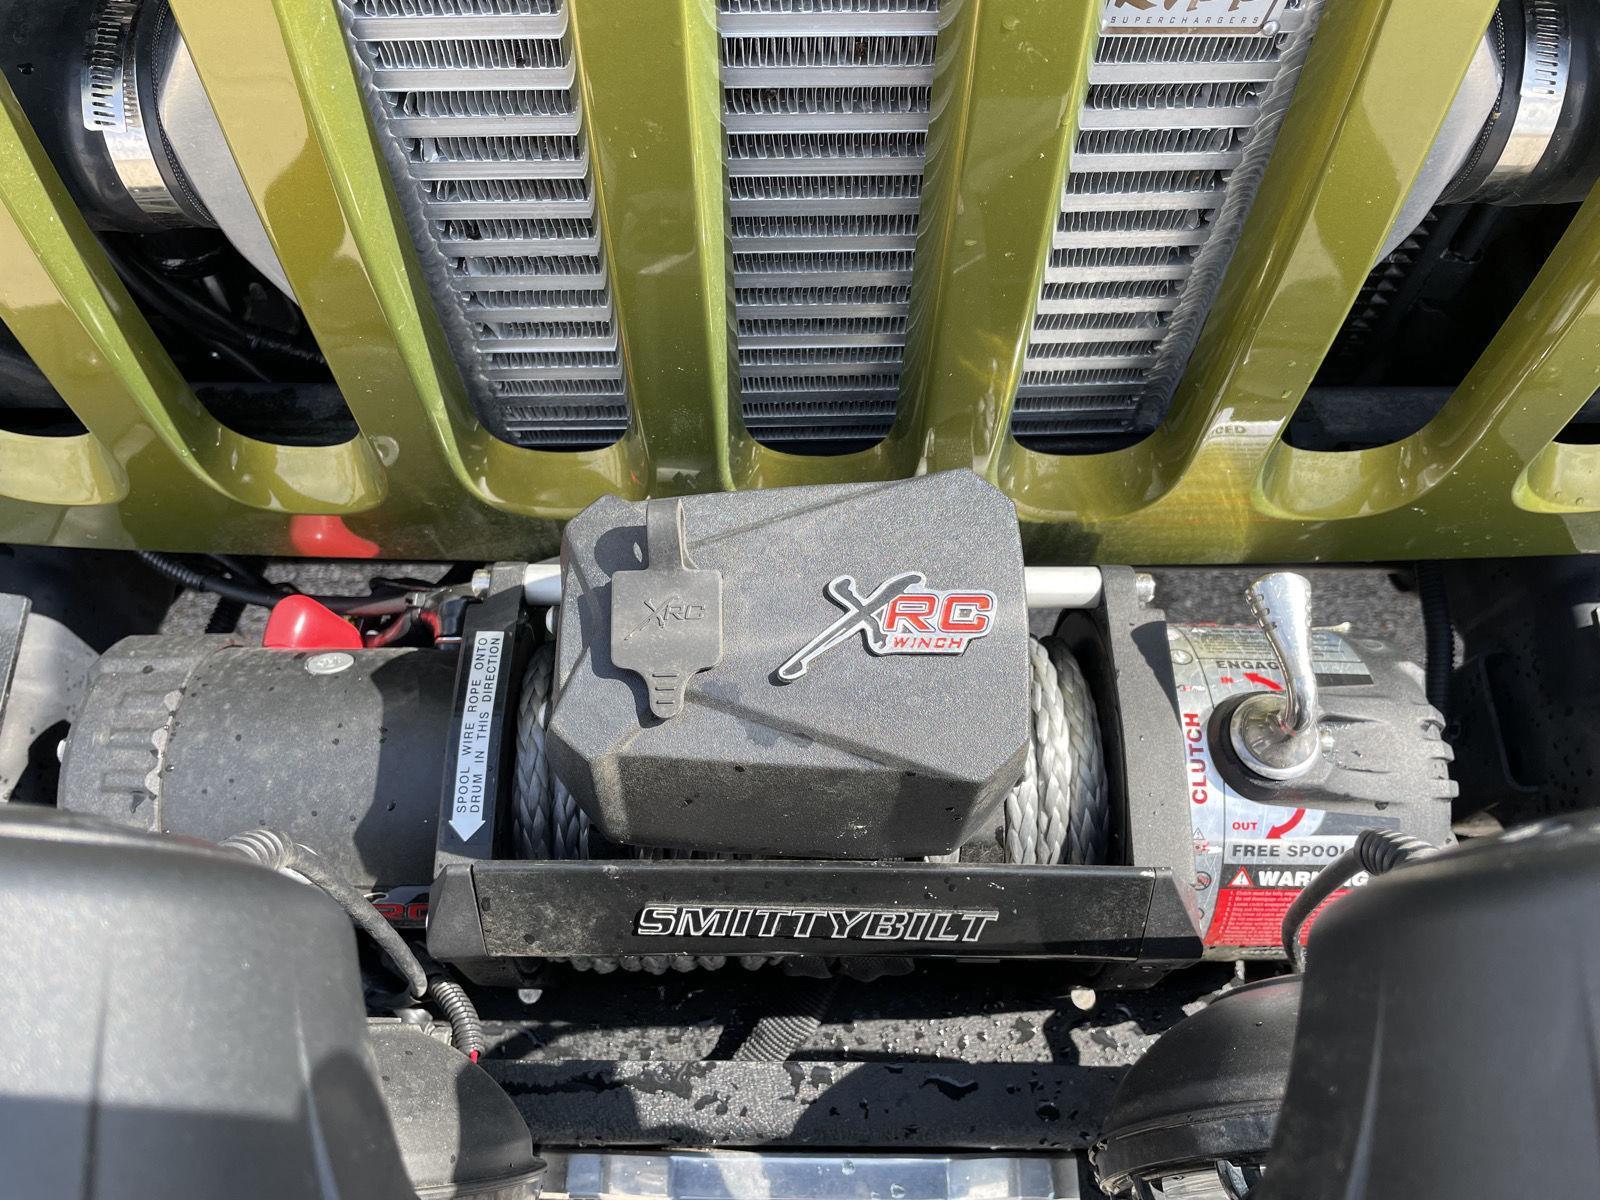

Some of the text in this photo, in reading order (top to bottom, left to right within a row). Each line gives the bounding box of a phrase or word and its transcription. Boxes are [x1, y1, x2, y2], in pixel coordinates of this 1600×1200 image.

[1110, 16, 1259, 25] SUPERCHARGERS
[777, 571, 997, 683] XRC
[893, 636, 963, 650] WINCH
[1216, 660, 1280, 670] ENGAG
[457, 637, 487, 813] SPOOL WIRE ROPE ONTO
[470, 637, 501, 813] DRUM IN THIS DIRECTION
[1183, 713, 1208, 805] CLUTCH
[1232, 821, 1258, 831] OUT
[1232, 844, 1280, 858] FREE
[1258, 871, 1369, 887] WARG
[636, 903, 999, 942] SMITTYBILT
